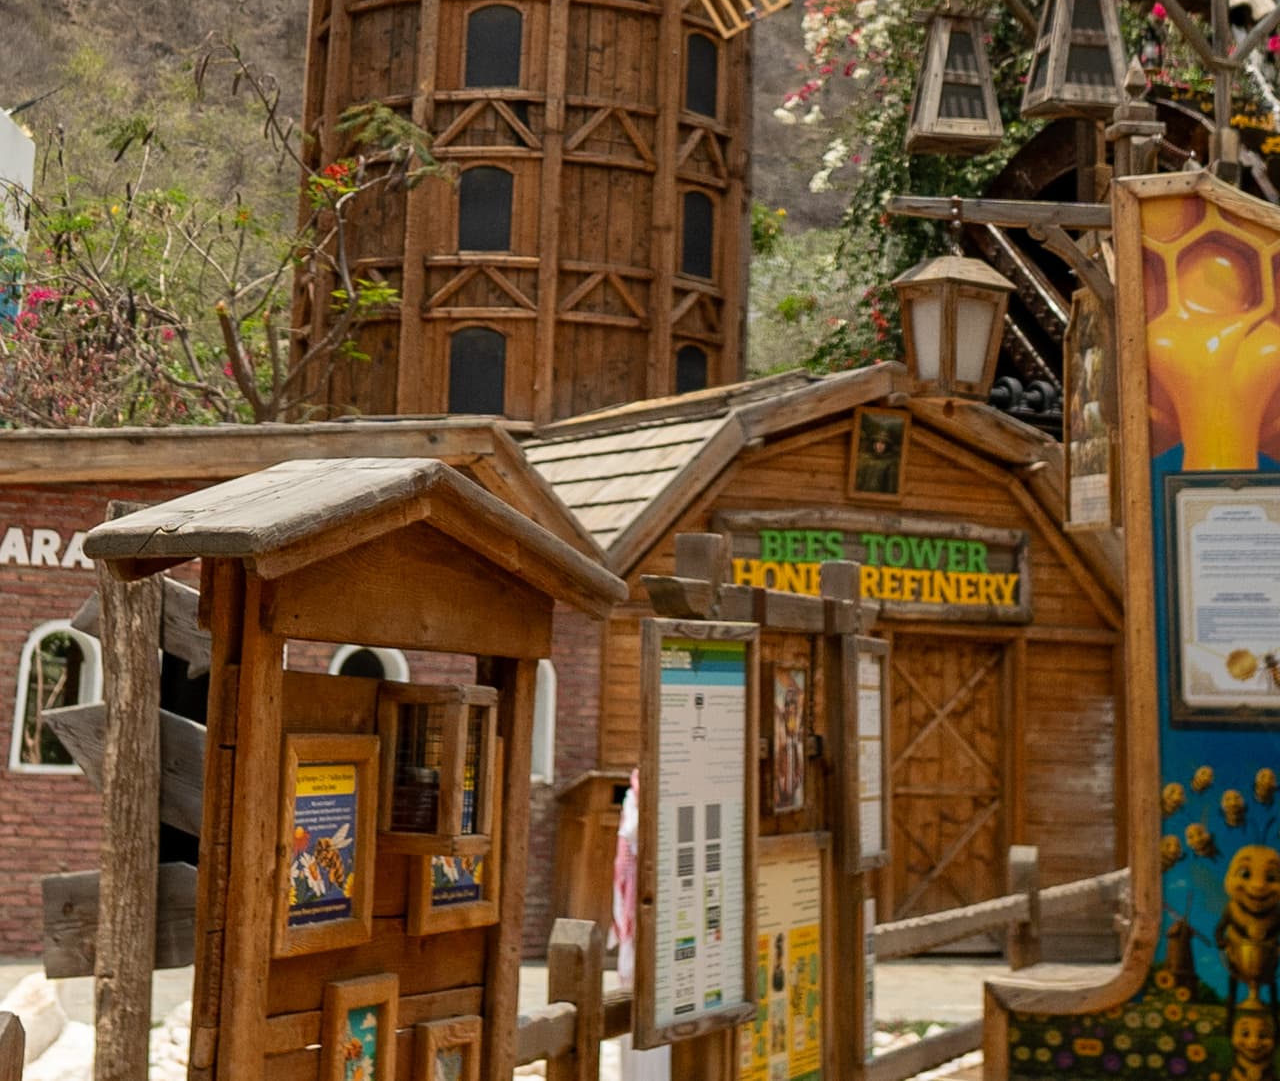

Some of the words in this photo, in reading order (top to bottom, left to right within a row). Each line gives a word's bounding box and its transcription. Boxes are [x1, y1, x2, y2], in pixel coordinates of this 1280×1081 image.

[759, 530, 844, 562] BEES
[862, 533, 989, 573] TOWER
[731, 558, 823, 597] HONE
[859, 565, 1019, 606] REFINERY
